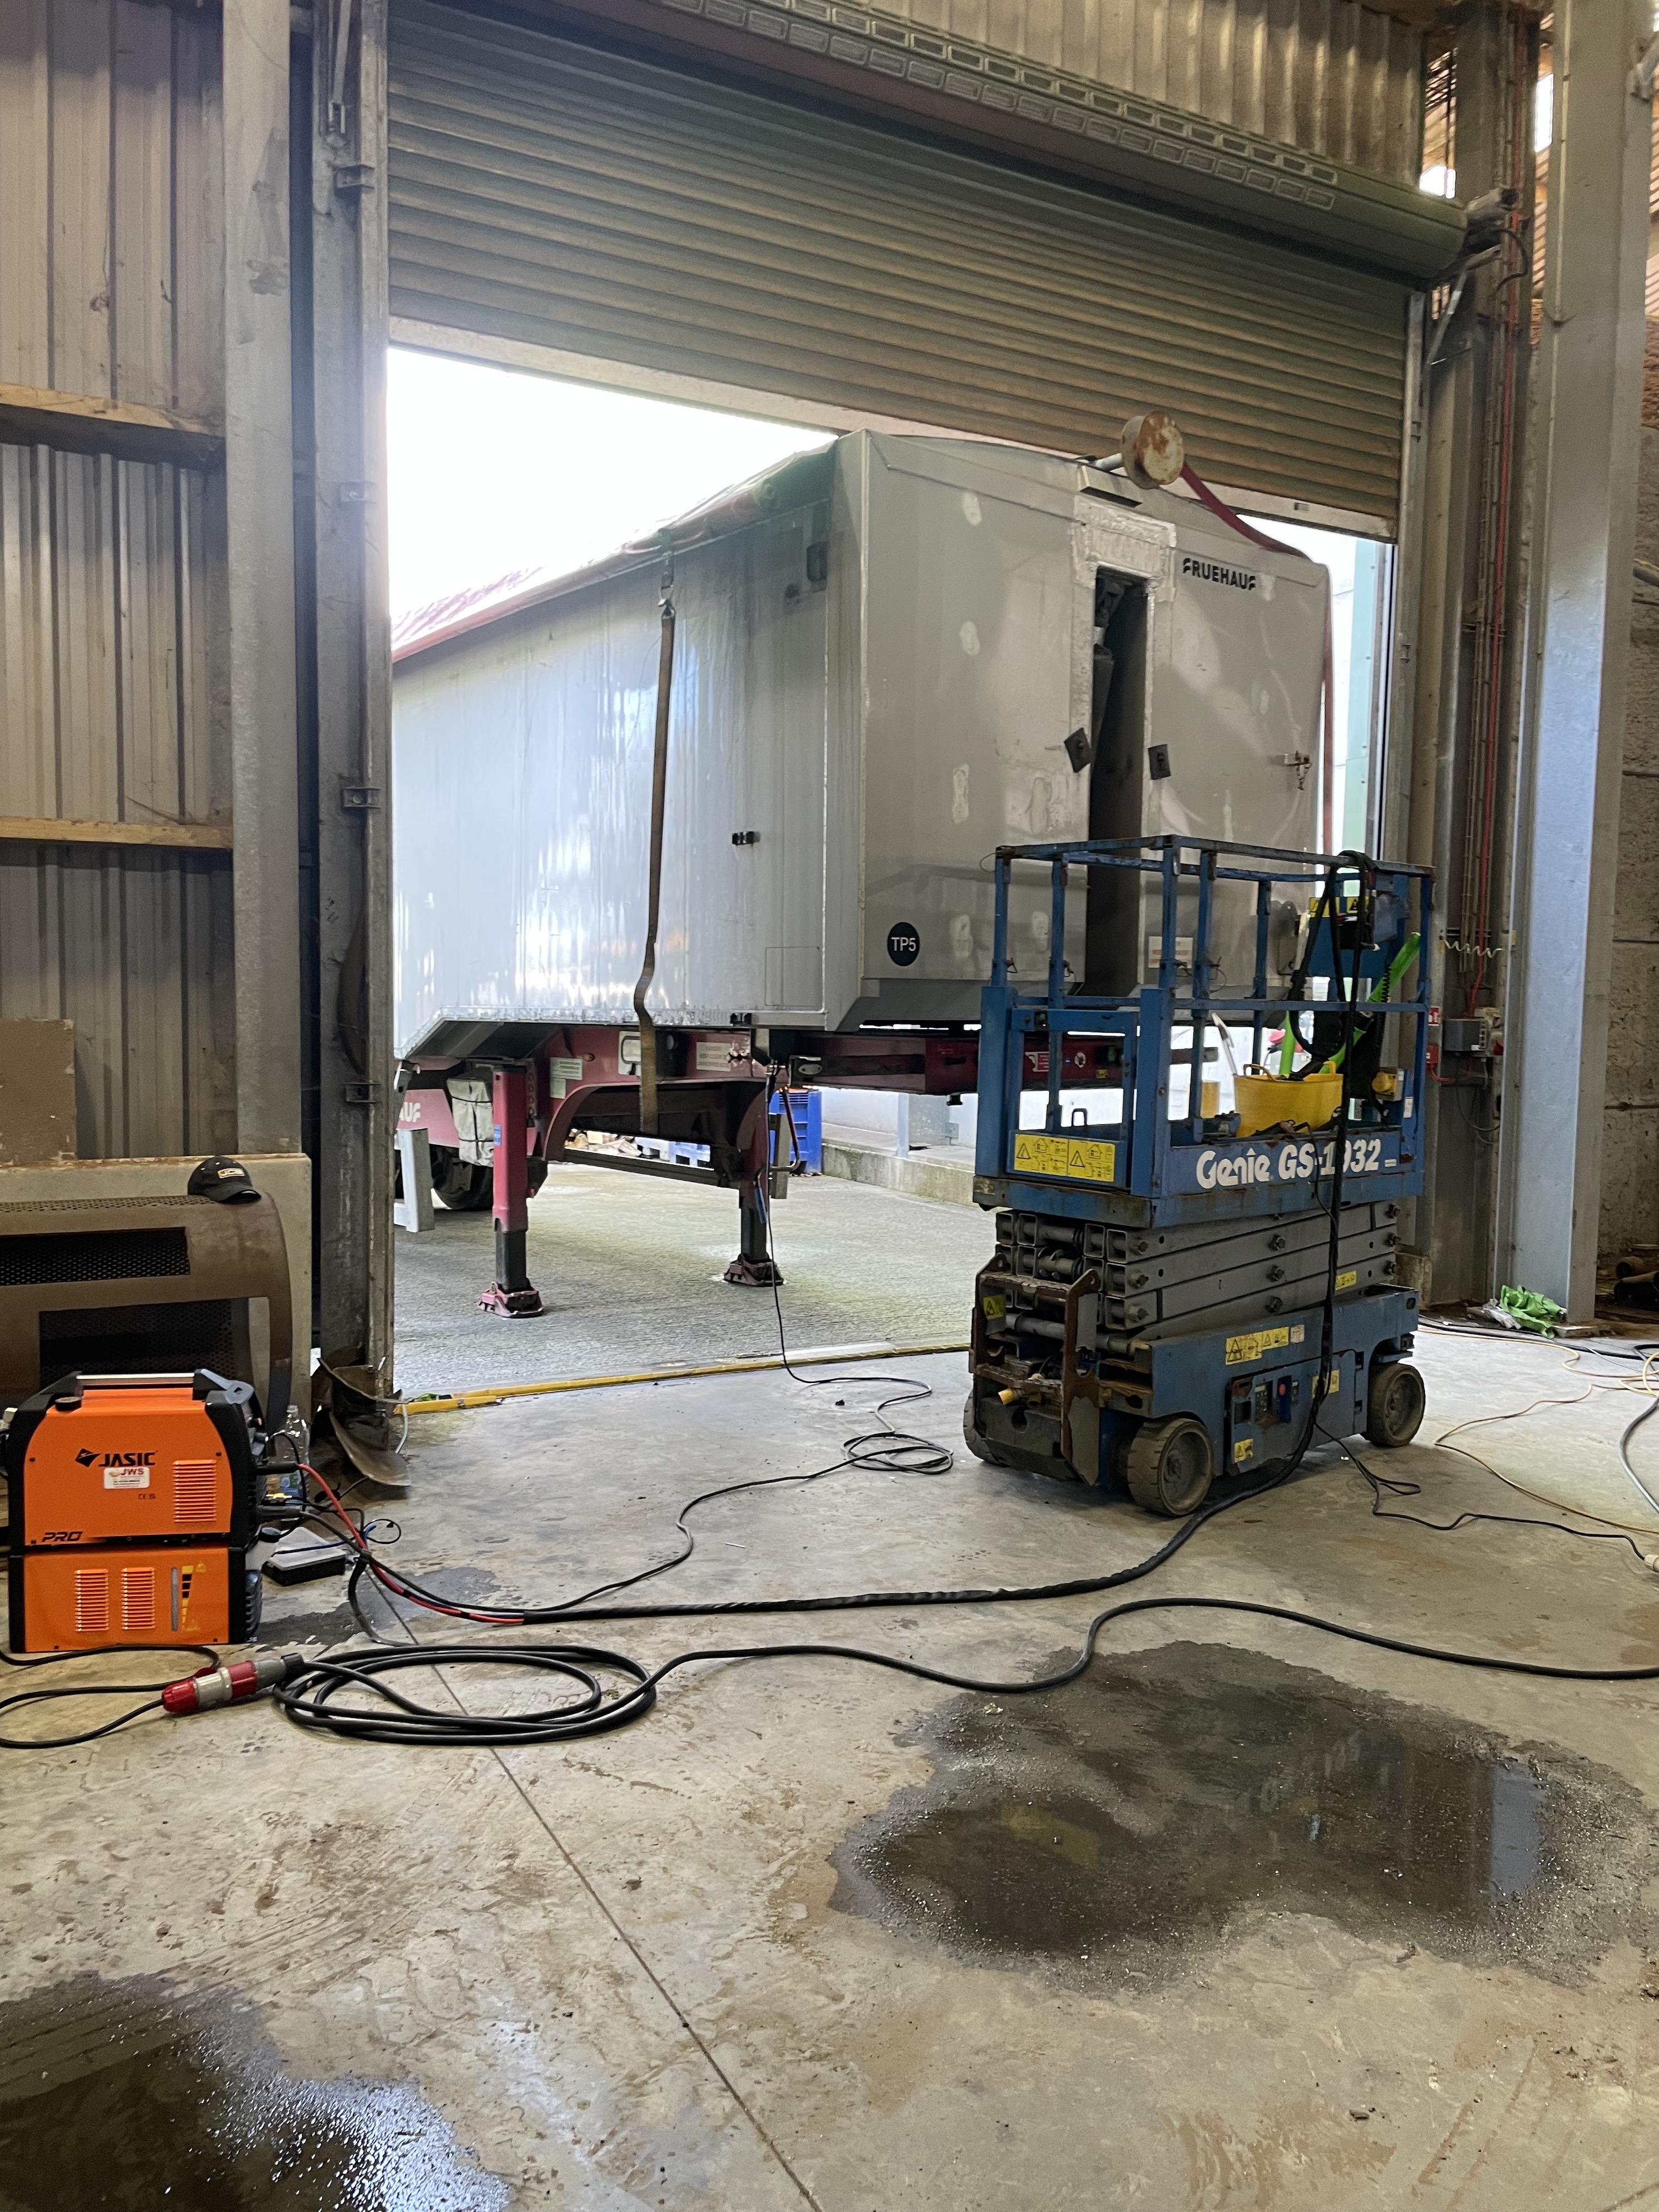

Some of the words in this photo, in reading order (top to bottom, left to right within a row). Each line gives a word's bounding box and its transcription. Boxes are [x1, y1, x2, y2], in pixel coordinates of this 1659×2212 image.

[1183, 557, 1256, 591] FRUEHAUF
[891, 937, 916, 951] TP5
[1196, 1147, 1271, 1189] Genie
[98, 1452, 156, 1467] JASIC
[42, 1531, 83, 1543] PRO
